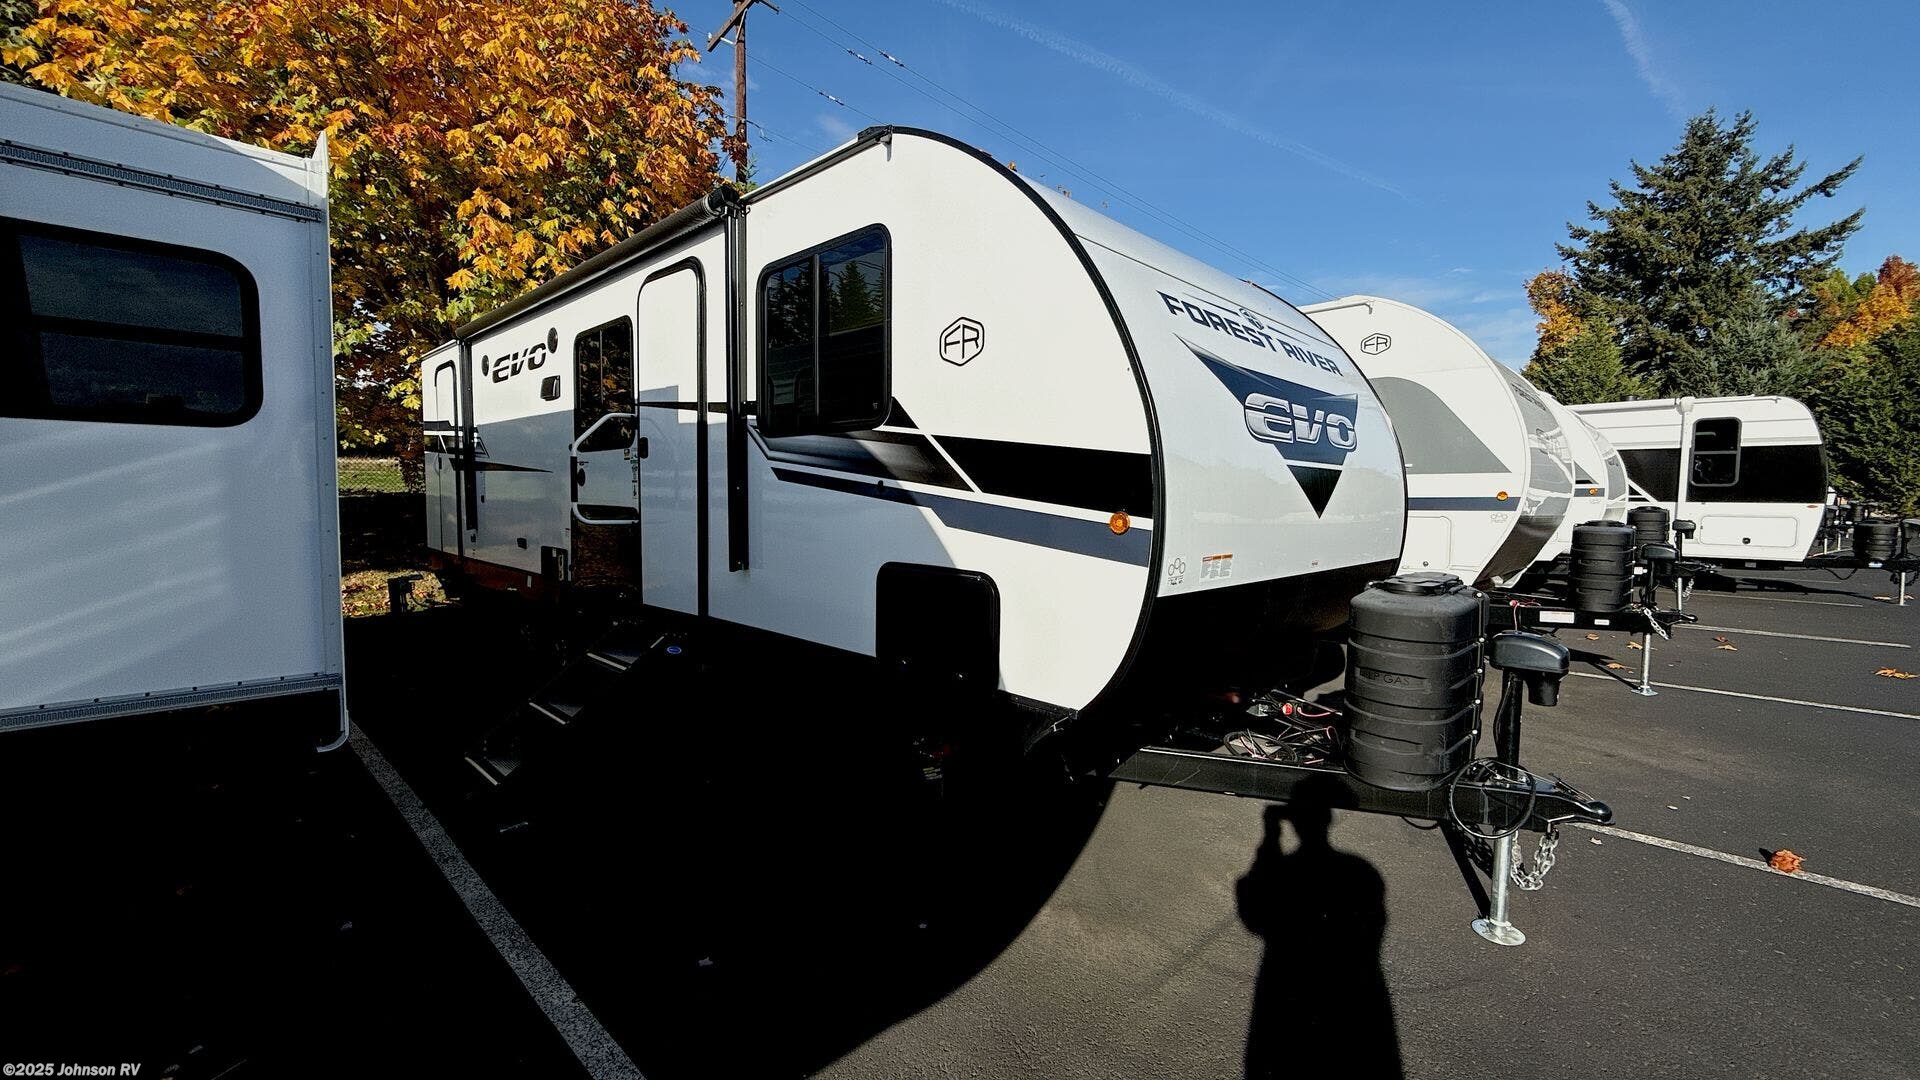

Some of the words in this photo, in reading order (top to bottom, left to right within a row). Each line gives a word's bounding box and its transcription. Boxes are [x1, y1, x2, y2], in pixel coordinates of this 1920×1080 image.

[943, 323, 980, 360] FR
[1155, 289, 1277, 352] FOREST
[1276, 338, 1344, 377] RIVER
[492, 342, 547, 383] EVO
[1244, 392, 1358, 452] EVO
[1383, 673, 1410, 686] GAS
